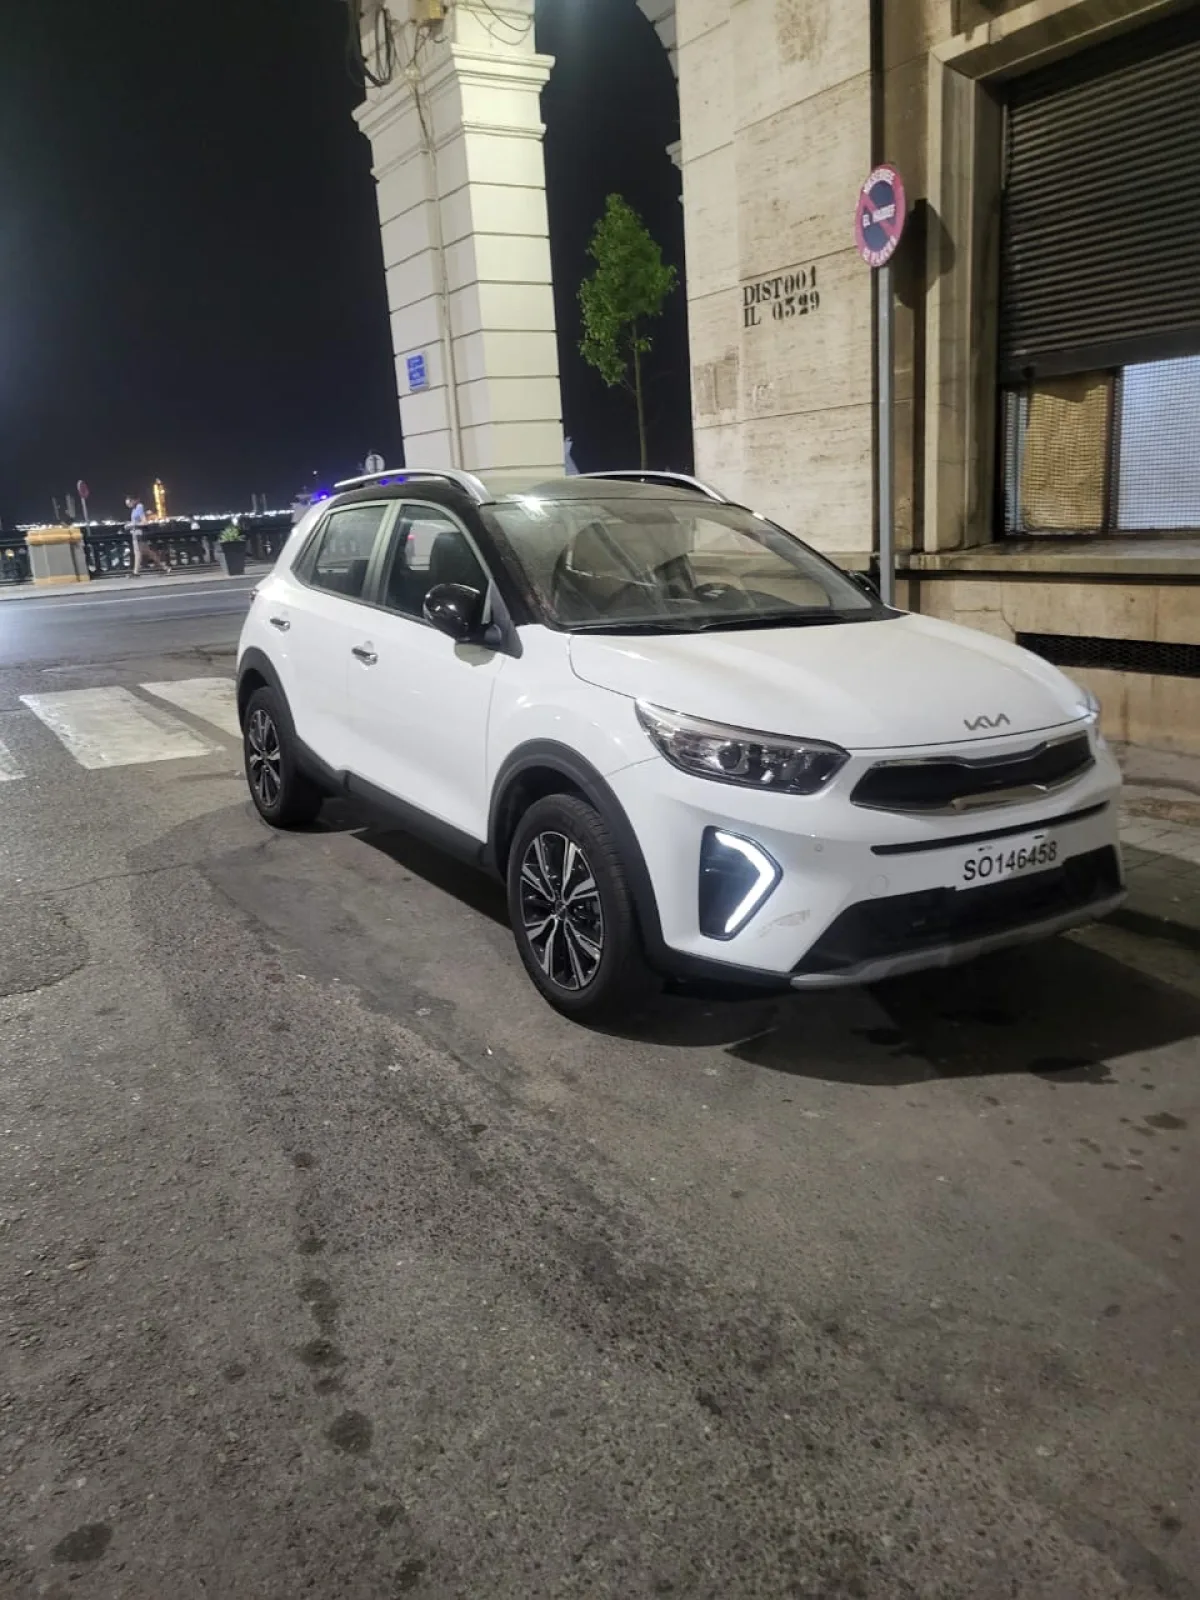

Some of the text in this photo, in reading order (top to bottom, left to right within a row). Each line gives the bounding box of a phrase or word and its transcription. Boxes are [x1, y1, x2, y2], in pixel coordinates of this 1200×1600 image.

[744, 306, 761, 328] IL
[963, 713, 1011, 731] KIA
[963, 840, 1058, 881] SO146458
